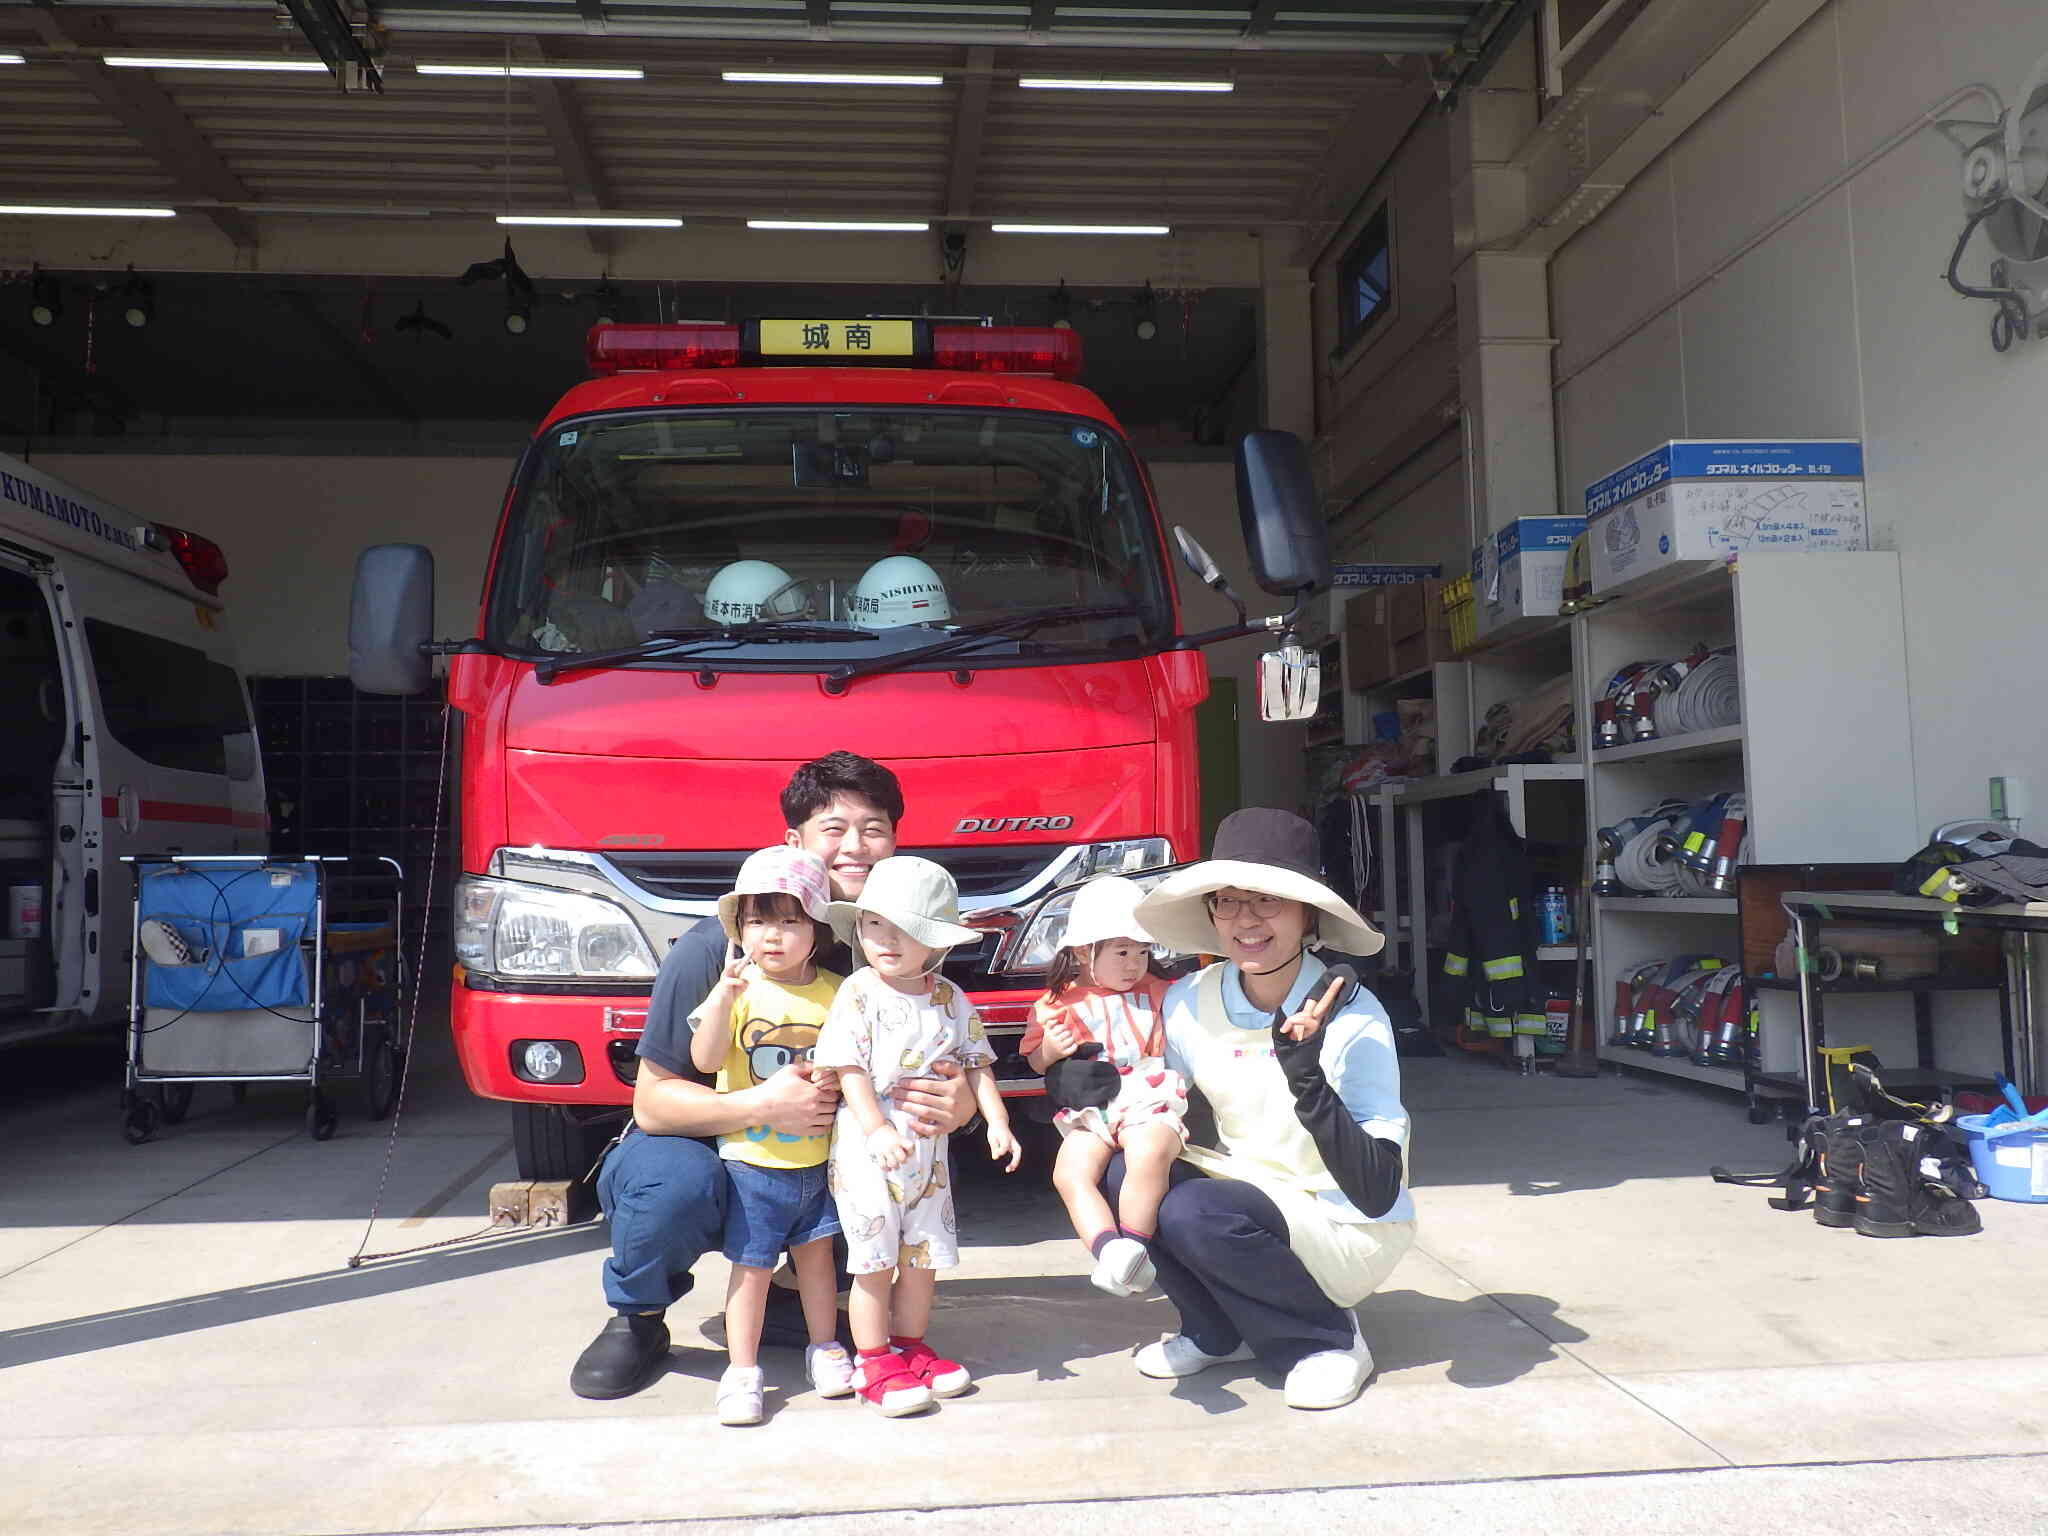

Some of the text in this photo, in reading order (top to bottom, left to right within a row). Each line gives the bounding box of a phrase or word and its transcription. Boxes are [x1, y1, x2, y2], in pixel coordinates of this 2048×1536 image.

[802, 323, 871, 351] 城南
[1, 471, 101, 536] KUMAMOTO
[954, 816, 1073, 832] DUTRO
